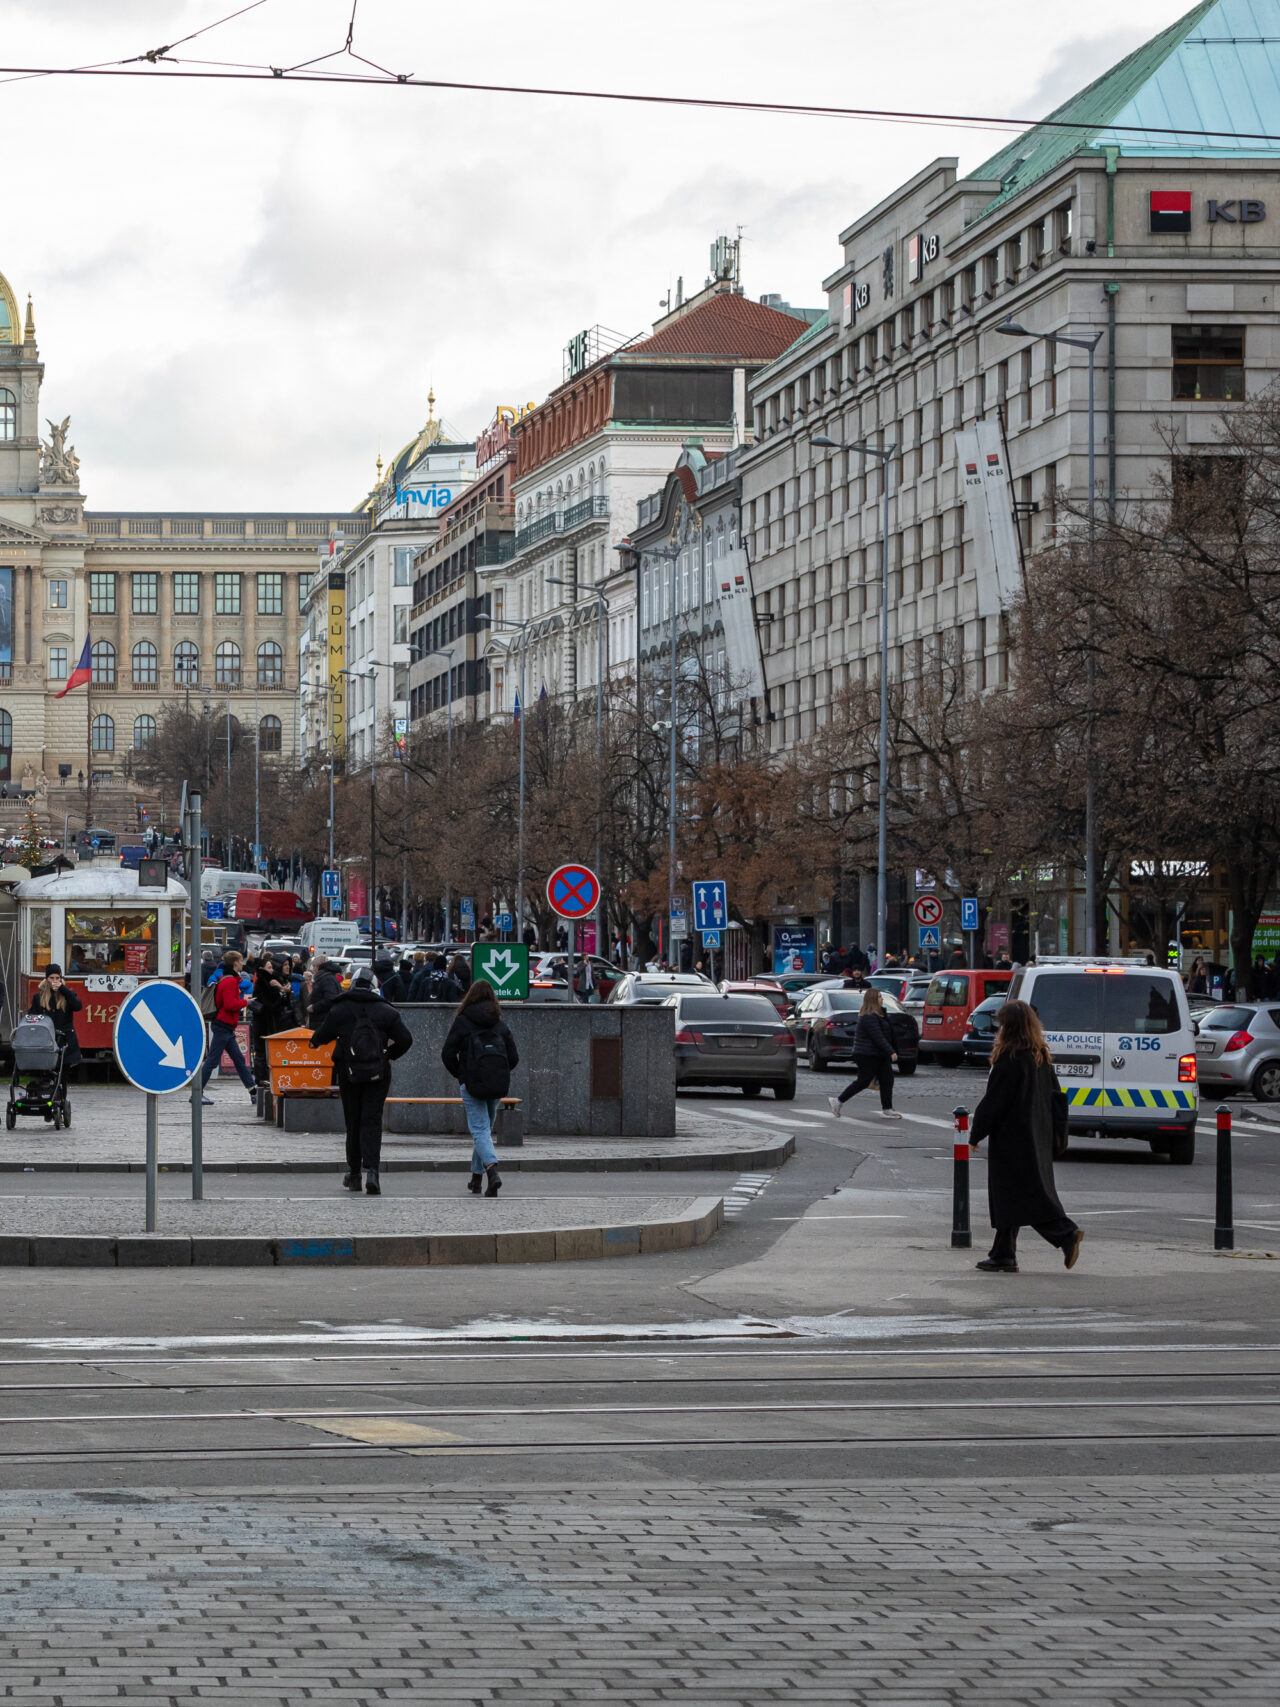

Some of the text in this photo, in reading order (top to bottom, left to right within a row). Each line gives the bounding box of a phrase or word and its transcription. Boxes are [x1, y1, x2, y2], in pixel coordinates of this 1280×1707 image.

[1207, 199, 1267, 223] KB
[923, 234, 938, 265] KB
[855, 283, 869, 312] KB
[987, 469, 1004, 477] KB
[966, 478, 981, 486] KB
[396, 484, 451, 508] invia
[331, 605, 343, 744] DŮM MÓDY
[965, 902, 974, 920] P
[503, 916, 510, 926] P
[98, 975, 125, 986] CAFE
[1213, 976, 1220, 985] P
[494, 988, 521, 996] stek A
[85, 1004, 120, 1023] 142
[1067, 1035, 1102, 1044] POLICIE
[1134, 1037, 1161, 1051] 156
[1068, 1065, 1089, 1074] 2982
